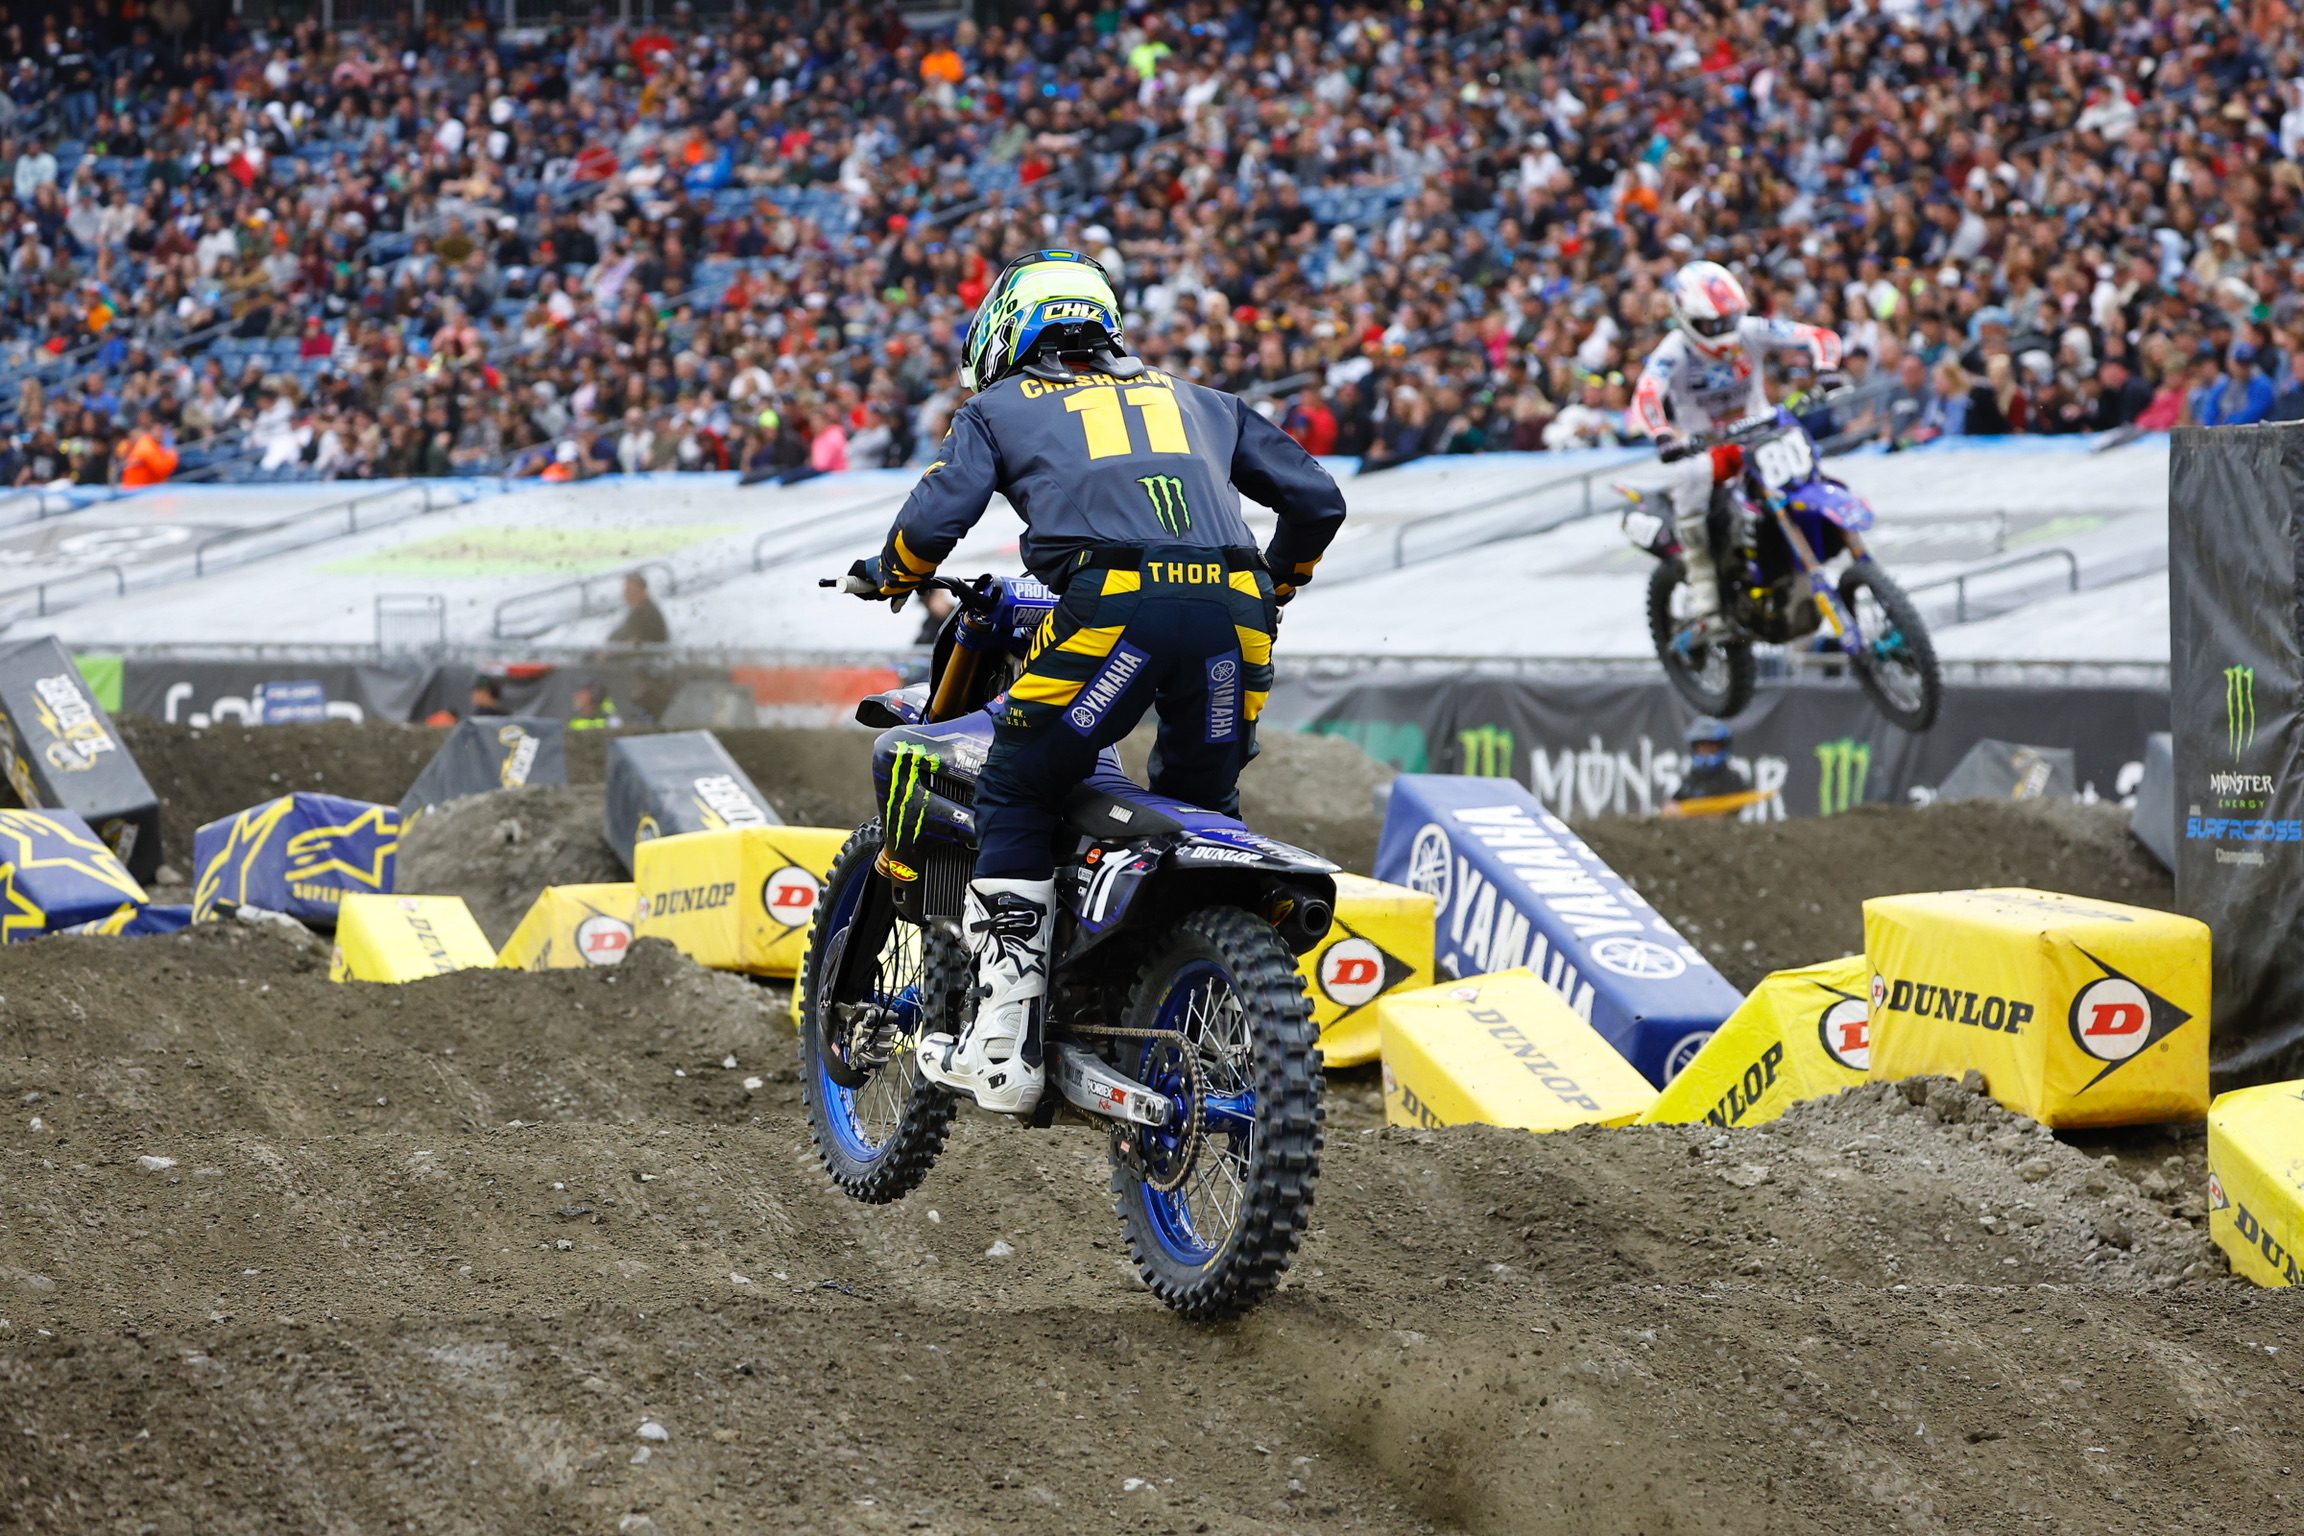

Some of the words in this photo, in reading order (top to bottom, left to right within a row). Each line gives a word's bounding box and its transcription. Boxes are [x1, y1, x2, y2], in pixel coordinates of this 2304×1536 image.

[1044, 302, 1105, 322] CHIZ
[1063, 385, 1191, 461] 11
[1755, 426, 1813, 489] 80
[1016, 582, 1060, 600] PROT
[1148, 562, 1221, 584] THOR
[1081, 651, 1143, 713] YAMAHA
[1531, 735, 1789, 823] MONSR
[2210, 770, 2275, 796] MONSTER
[2218, 799, 2266, 809] ENERGY
[2185, 817, 2302, 842] SUPERCROSS
[1190, 845, 1263, 863] DUNLOP
[1451, 804, 1645, 939] YAMAHA
[653, 883, 736, 917] DUNLOP
[1081, 848, 1142, 922] 11
[1328, 958, 1378, 985] D
[1887, 979, 2035, 1035] DUNLOP
[2084, 1003, 2145, 1036] D
[1467, 1008, 1602, 1111] DUNLOP
[1702, 1041, 1784, 1128] NLOP
[2234, 1201, 2304, 1286] DUN
